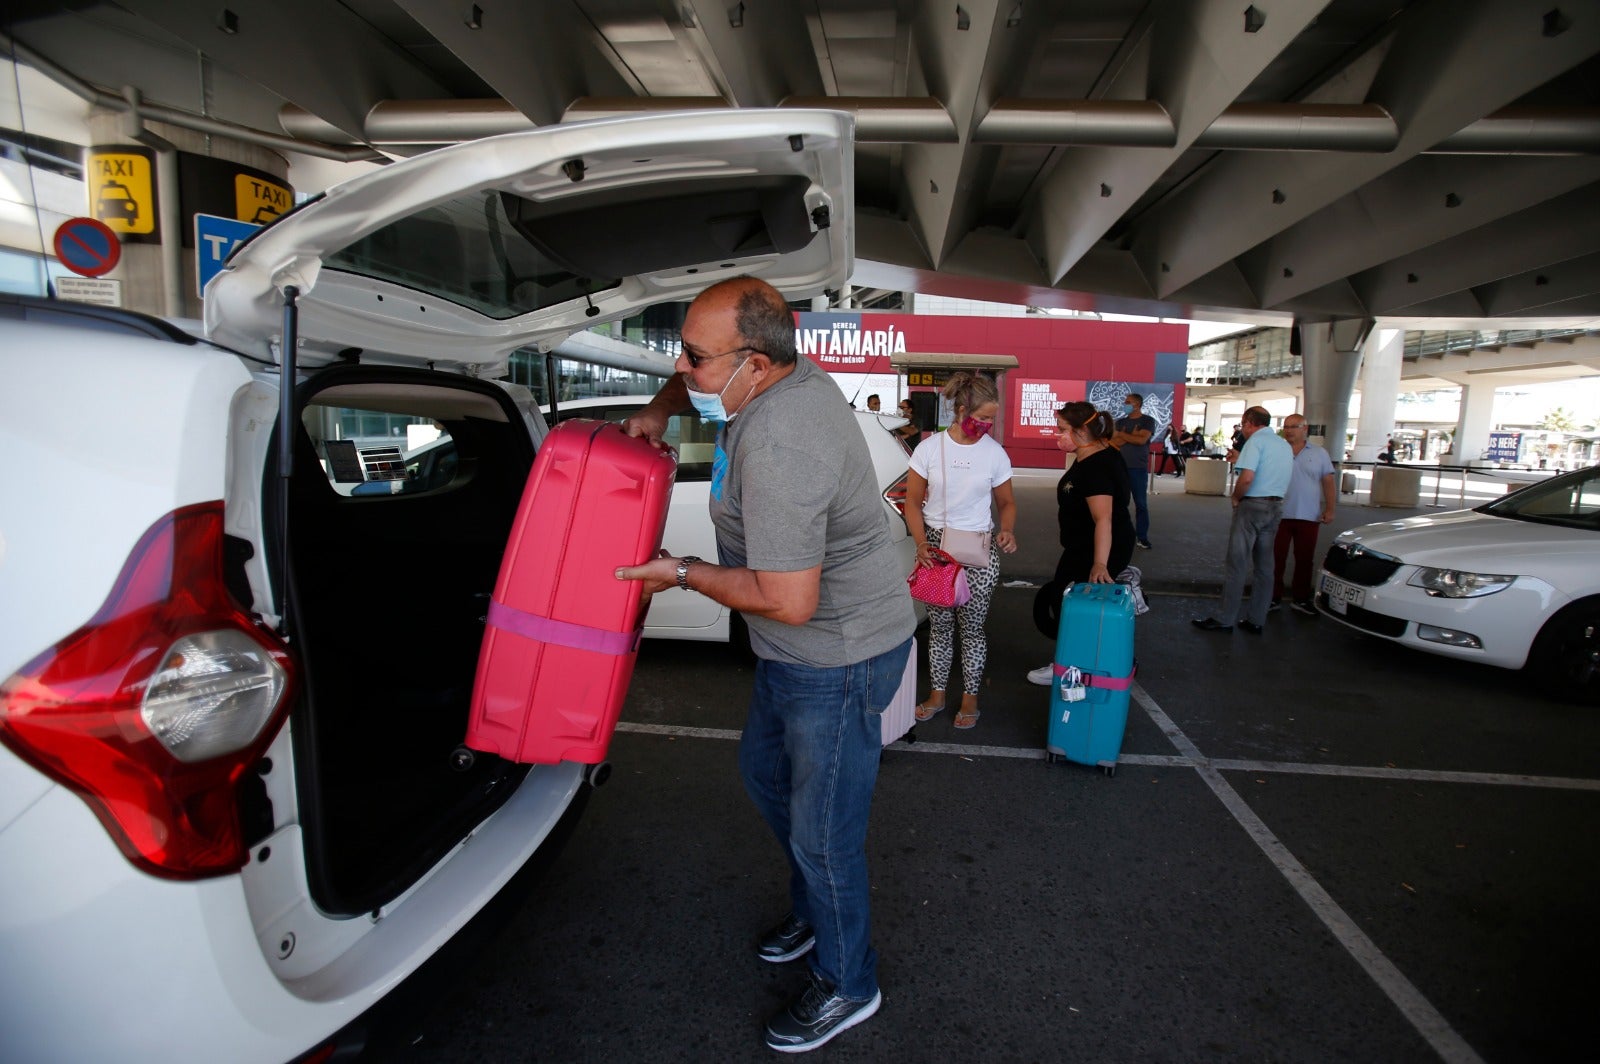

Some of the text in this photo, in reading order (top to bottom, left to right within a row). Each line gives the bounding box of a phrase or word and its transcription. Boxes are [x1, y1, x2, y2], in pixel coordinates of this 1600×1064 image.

[95, 159, 134, 177] TAXI
[250, 181, 287, 208] TAXI
[795, 325, 906, 357] ANTAMARÍA
[1022, 383, 1050, 392] SABEMOS
[1052, 401, 1067, 410] REC
[1020, 417, 1028, 426] LA
[1498, 437, 1519, 449] HERE
